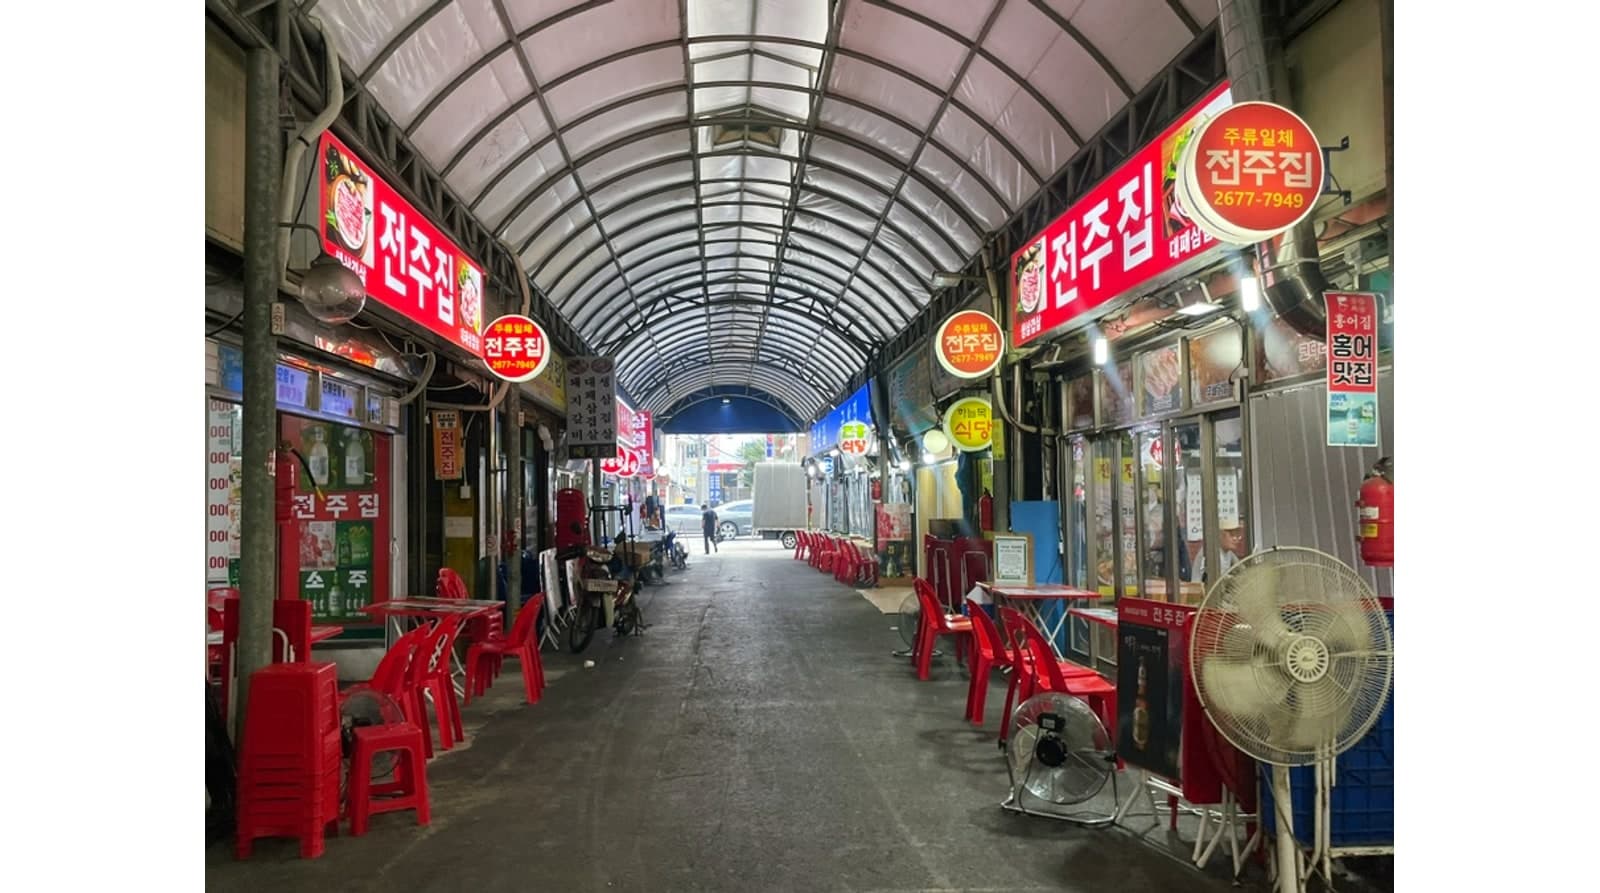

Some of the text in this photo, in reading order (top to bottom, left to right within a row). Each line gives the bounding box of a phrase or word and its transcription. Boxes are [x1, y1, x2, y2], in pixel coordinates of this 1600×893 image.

[1224, 128, 1294, 148] 주류일체
[1206, 149, 1312, 188] 전주집
[1214, 191, 1304, 208] 2677-7949
[1051, 161, 1153, 309] 전주집
[380, 201, 454, 327] 전주집
[1334, 314, 1371, 329] 홍어집
[485, 337, 541, 357] 전주집
[946, 333, 997, 353] 전주집
[1333, 334, 1372, 358] 홍어
[1334, 361, 1372, 385] 맛집
[955, 421, 992, 440] 식당
[294, 494, 379, 518] 전주집
[1154, 607, 1185, 626] 전주집
